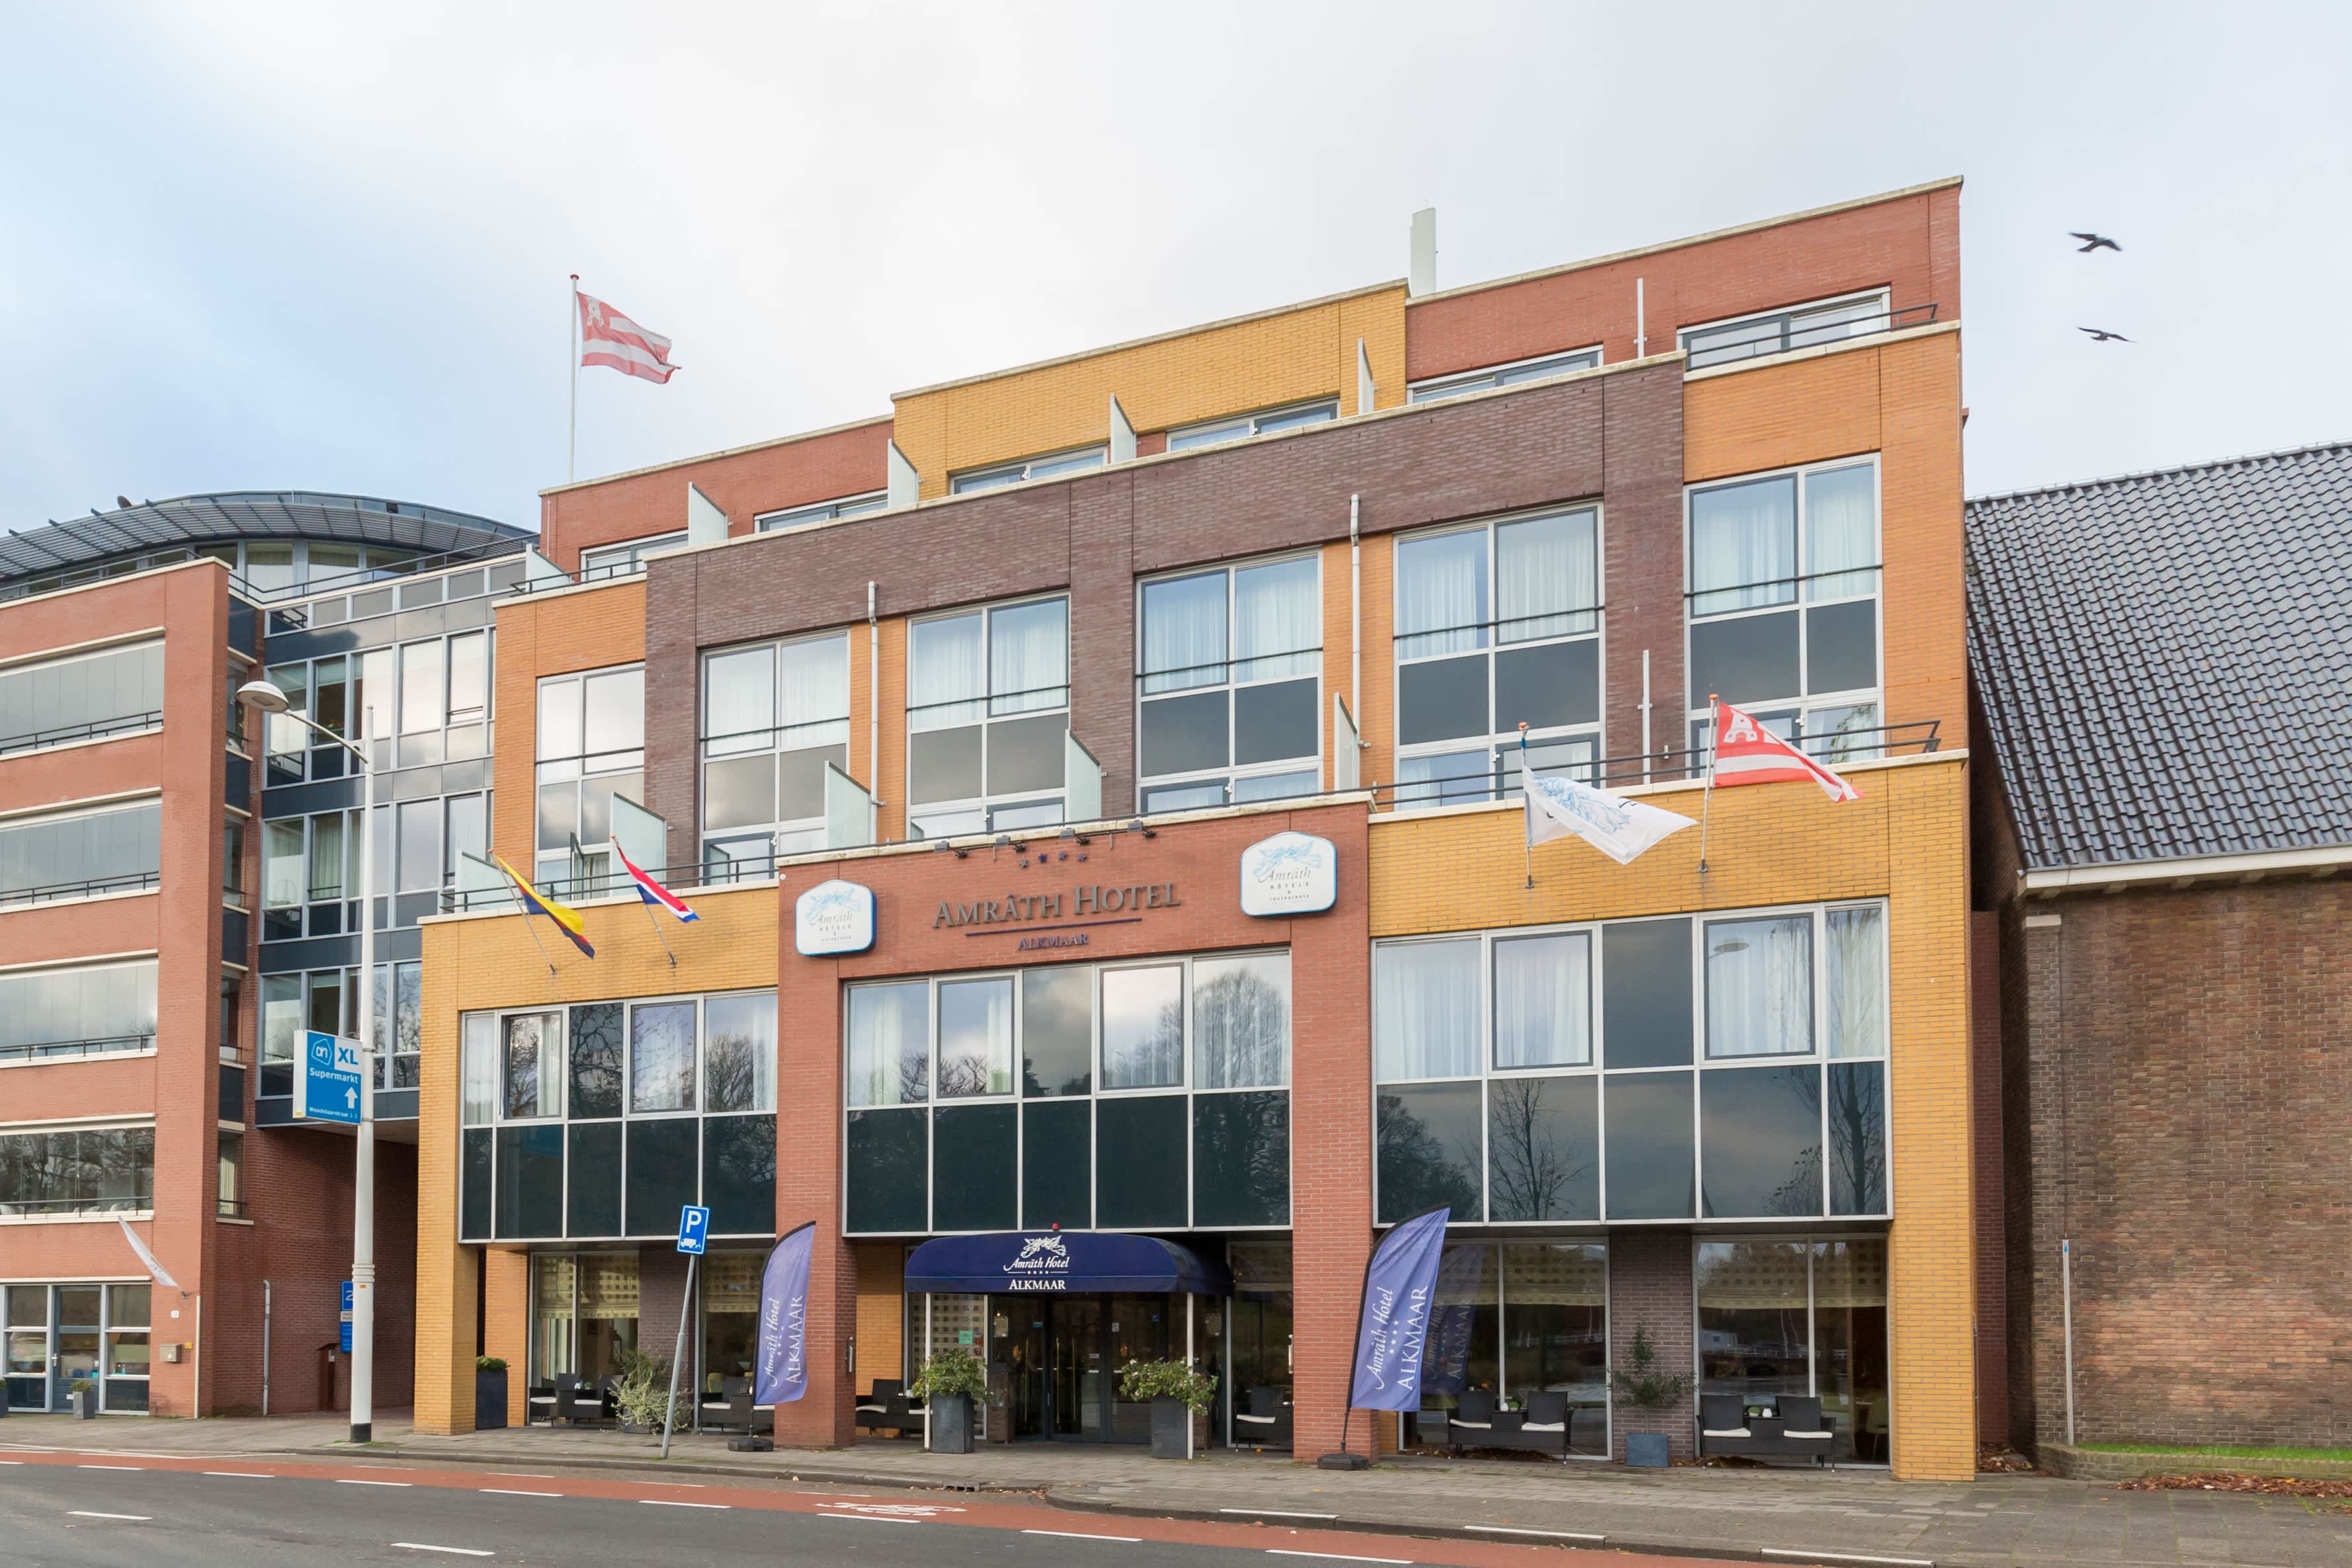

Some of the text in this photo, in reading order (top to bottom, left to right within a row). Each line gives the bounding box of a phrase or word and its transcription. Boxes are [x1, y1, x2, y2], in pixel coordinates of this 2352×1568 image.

[932, 883, 1181, 928] AMRÂTH HOTEL
[1018, 933, 1089, 951] ALKMAAR
[338, 1047, 358, 1065] XL
[310, 1067, 358, 1083] Supermarkt
[686, 1210, 702, 1233] P
[1045, 1256, 1070, 1268] Hotel
[1009, 1279, 1066, 1290] ALKMAAR
[765, 1297, 780, 1331] Hotel
[1366, 1286, 1394, 1390] Amrâth Hotel
[1397, 1286, 1428, 1391] ALKMAAR
